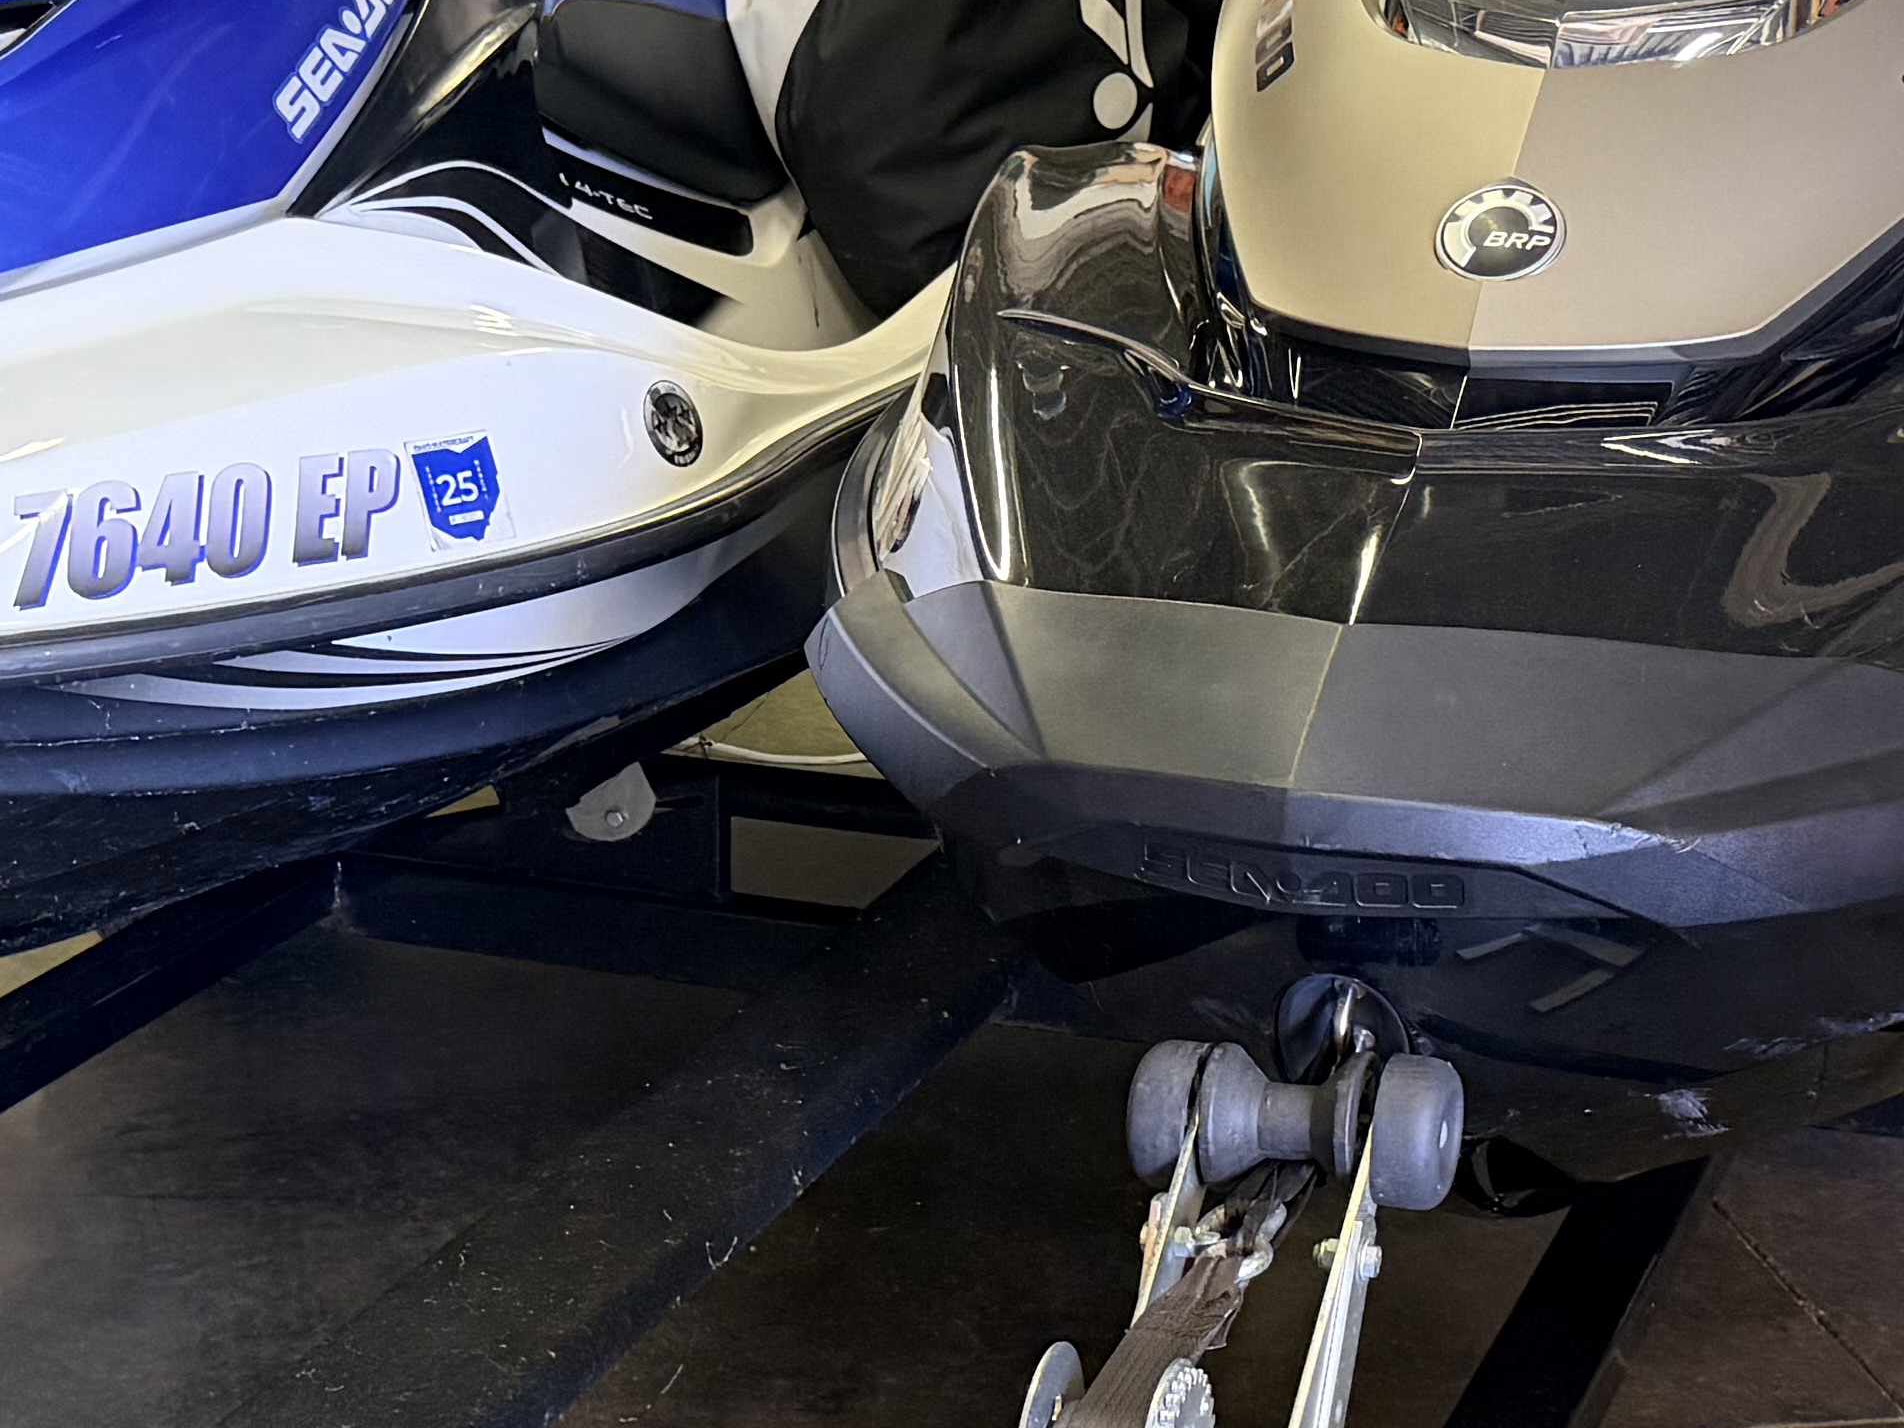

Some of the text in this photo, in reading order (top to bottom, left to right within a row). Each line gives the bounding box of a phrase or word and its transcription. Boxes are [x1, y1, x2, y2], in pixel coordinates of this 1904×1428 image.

[1482, 230, 1552, 251] BRP
[435, 469, 480, 507] 25
[13, 462, 272, 612] 7640
[292, 448, 401, 567] EP
